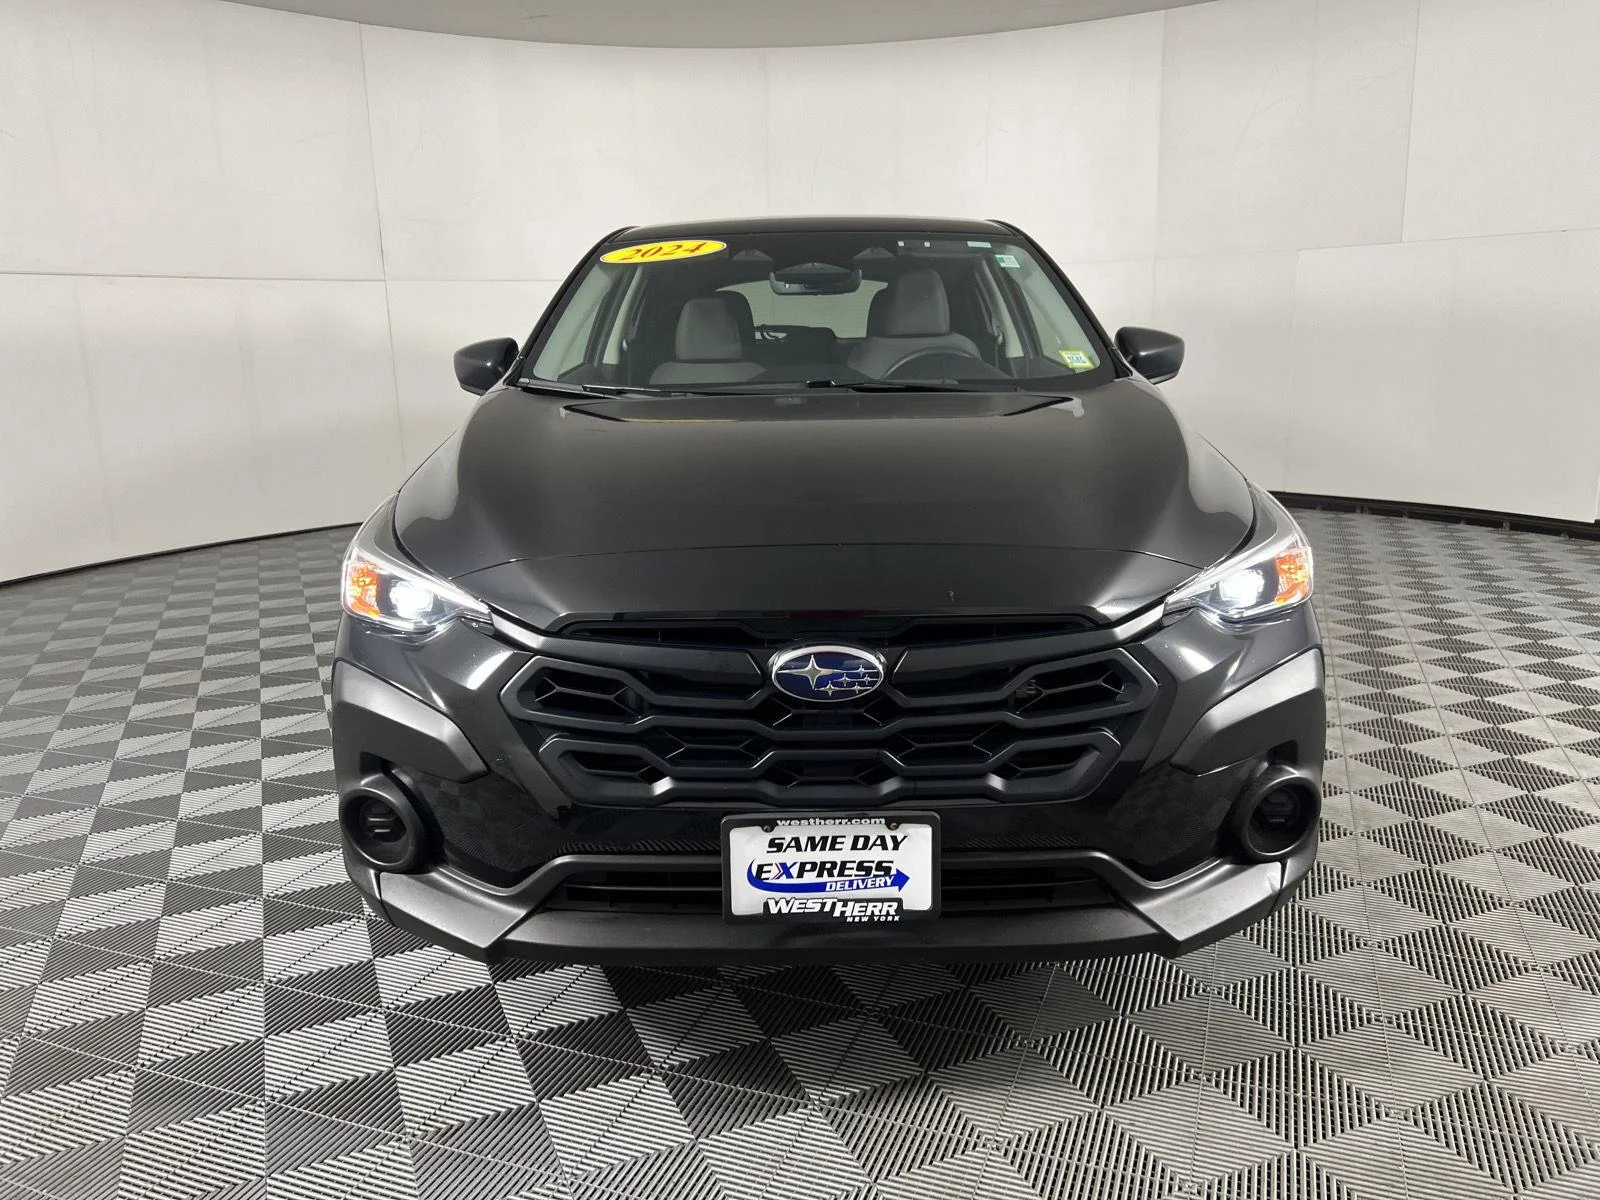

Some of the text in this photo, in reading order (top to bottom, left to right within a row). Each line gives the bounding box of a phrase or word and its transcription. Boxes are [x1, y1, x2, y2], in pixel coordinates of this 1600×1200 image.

[618, 242, 707, 260] 2024
[777, 818, 886, 826] westherr.com
[767, 835, 908, 853] SAME DAY
[755, 860, 894, 880] EXPRESS
[825, 876, 895, 891] DELIVERY
